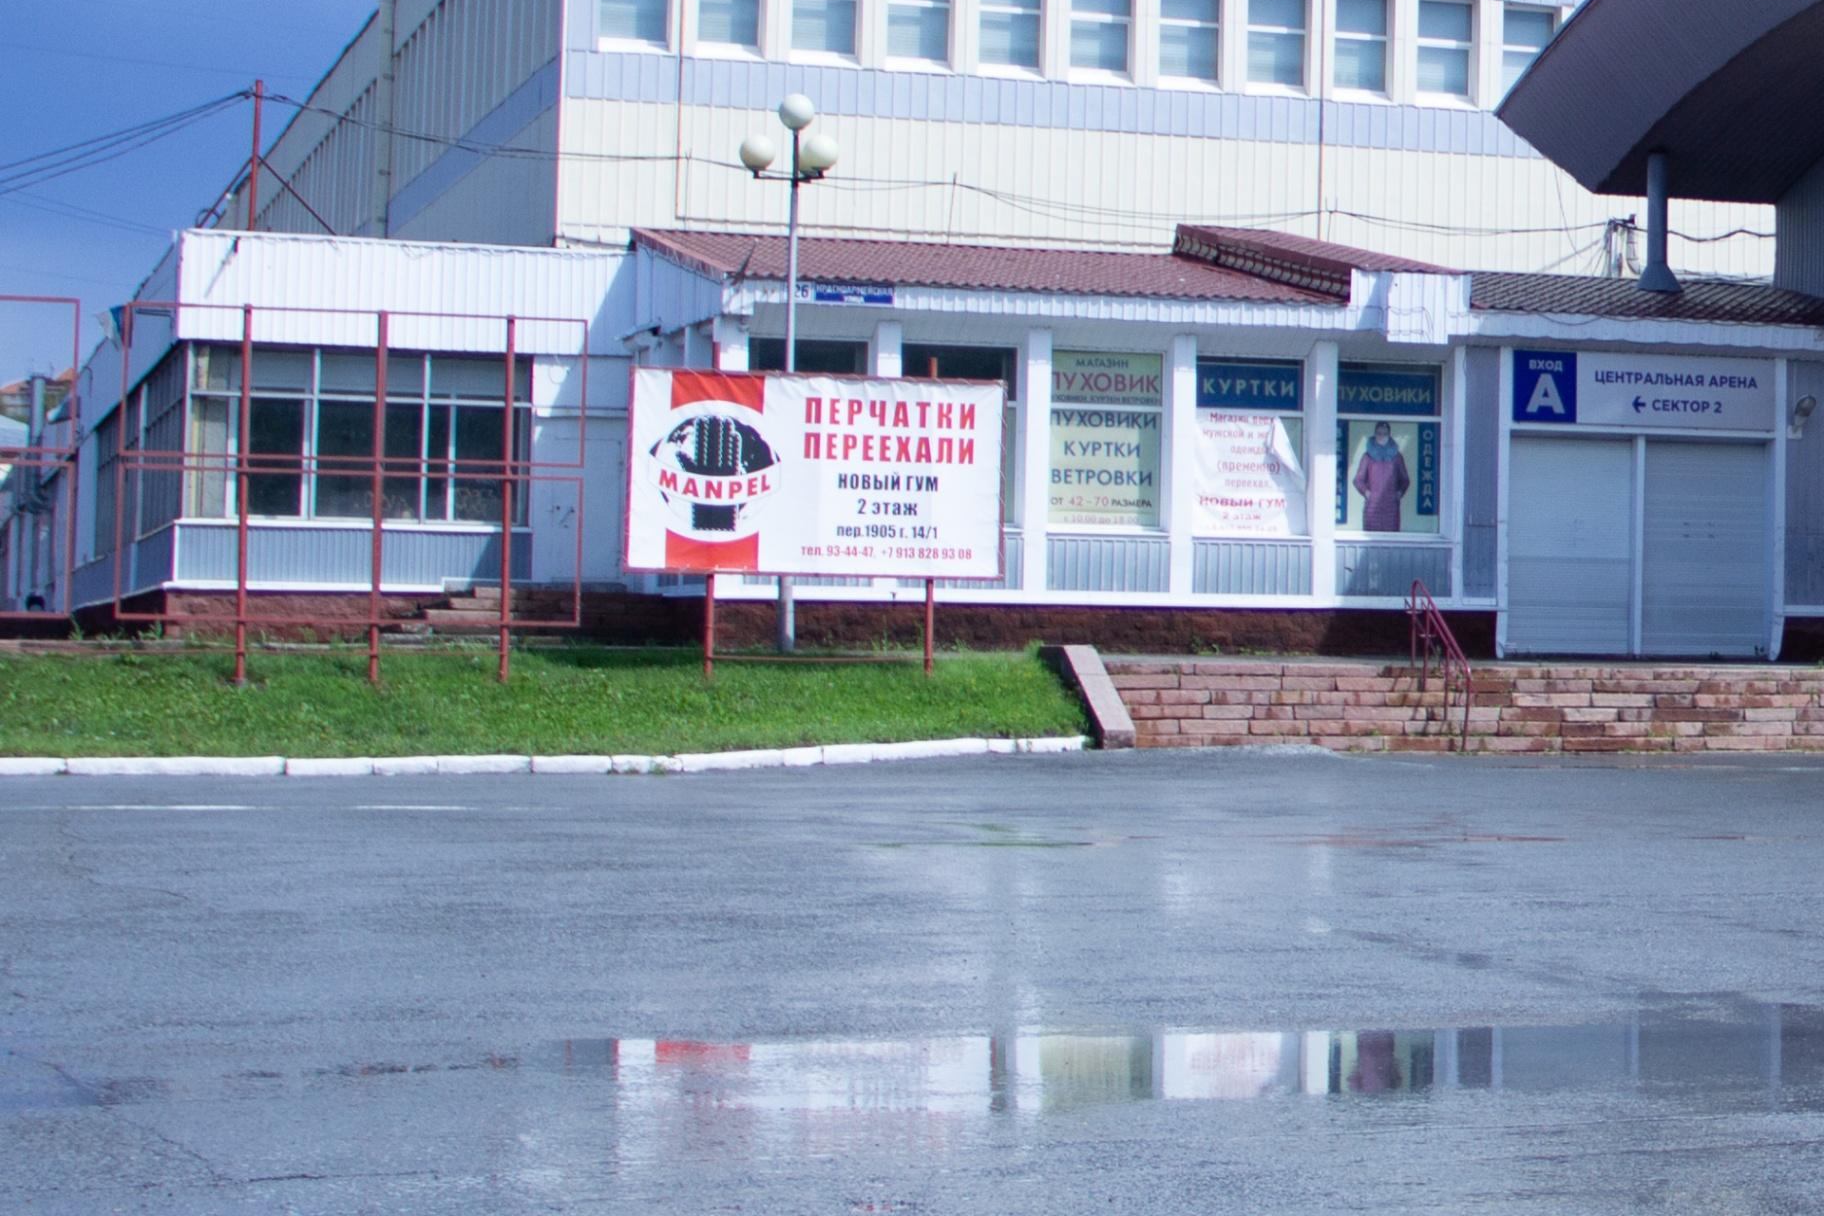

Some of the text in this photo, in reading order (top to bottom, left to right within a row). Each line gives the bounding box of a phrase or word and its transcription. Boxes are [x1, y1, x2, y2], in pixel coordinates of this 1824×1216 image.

[1075, 358, 1129, 369] МАГАЗИН
[1529, 359, 1563, 372] ВХОД
[1203, 378, 1295, 398] КУРТКИ
[1594, 370, 1758, 390] ЦЕНТРАЛЬНАЯ АРЕНА
[1525, 373, 1566, 415] А
[805, 396, 976, 430] ПЕРЧАТКИ
[1652, 399, 1723, 414] СЕКТОР 2
[803, 432, 974, 465] ПЕРЕЕХАЛИ
[1064, 440, 1141, 458] КУРТКИ
[1051, 468, 1152, 487] ВЕТРОВКИ
[1422, 429, 1434, 509] ОДЕЖДА
[658, 468, 771, 500] MANPEL
[838, 471, 939, 493] НОВЫЙ ГУМ
[857, 498, 918, 516] 2 этаж
[1111, 498, 1152, 508] РАЗМЕРА
[911, 525, 938, 540] 14/1
[896, 546, 915, 559] 913
[918, 547, 939, 560] 828
[941, 548, 956, 560] 93
[958, 548, 972, 560] 08
